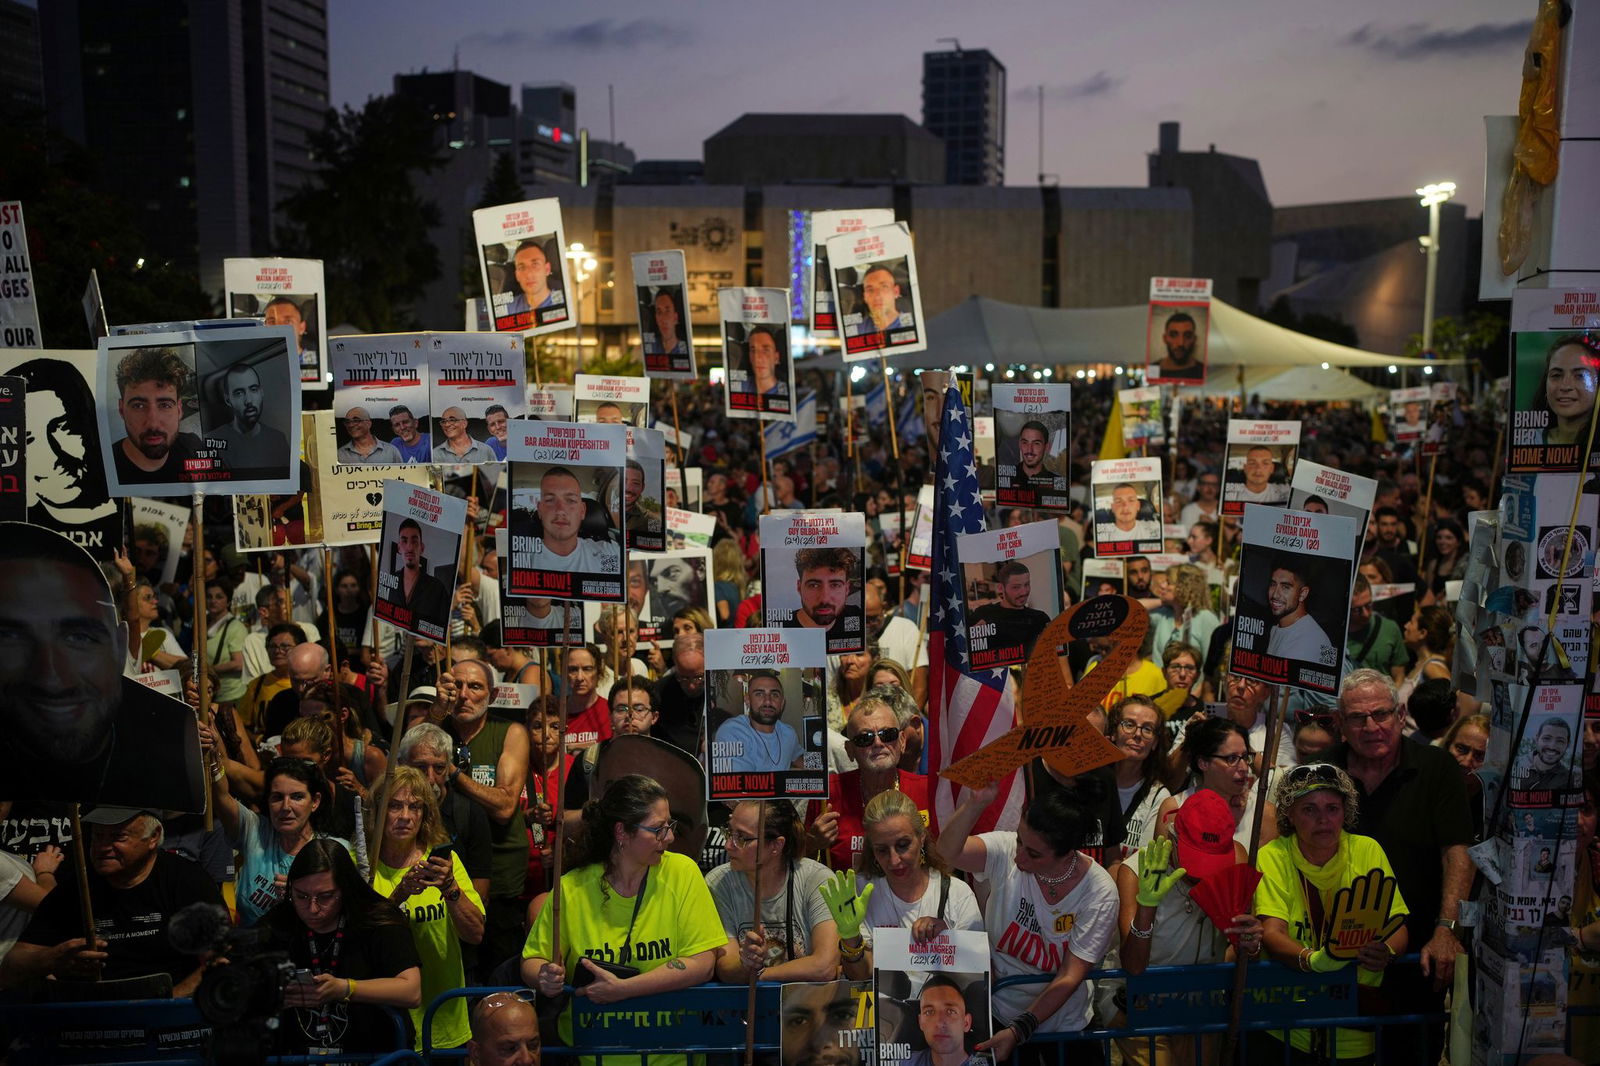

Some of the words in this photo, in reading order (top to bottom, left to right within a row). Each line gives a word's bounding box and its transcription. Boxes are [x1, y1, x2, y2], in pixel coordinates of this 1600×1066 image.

[6, 255, 30, 273] ALL
[0, 278, 30, 299] GES
[1576, 303, 1600, 314] HAYMA
[4, 327, 36, 347] OUR
[353, 351, 388, 366] וליאור
[390, 351, 407, 366] טל
[449, 351, 484, 366] וליאור
[487, 351, 503, 366] טל
[346, 366, 378, 382] לחזור
[382, 368, 418, 382] חייבים
[441, 367, 473, 381] לחזור
[477, 368, 513, 381] חייבים
[1514, 411, 1549, 429] BRING
[525, 436, 537, 446] BAR
[538, 437, 566, 449] ABRAHAM
[568, 440, 610, 450] KUPERSHTEIN
[1513, 428, 1535, 446] HER
[1512, 447, 1544, 465] HOME
[1545, 445, 1580, 465] NOW!
[998, 464, 1017, 477] BRING
[788, 527, 799, 536] GUY
[800, 526, 840, 536] GILBOA-DALAL
[1275, 523, 1297, 537] EVYATAR
[1298, 527, 1320, 539] DAVID
[512, 535, 543, 554] BRING
[996, 542, 1007, 551] ITAY
[1008, 538, 1022, 550] CHEN
[512, 552, 532, 569] HIM
[512, 570, 541, 588] HOME
[543, 572, 573, 591] NOW!
[503, 605, 526, 618] BRING
[767, 608, 793, 621] BRING
[969, 622, 997, 640] BRING
[1237, 613, 1265, 636] BRING
[1235, 631, 1255, 650] HIM
[1563, 629, 1582, 638] שהם
[743, 644, 763, 654] SEGEV
[764, 643, 788, 653] KALFON
[970, 637, 988, 652] HIM
[971, 650, 997, 665] HOME
[998, 643, 1025, 661] NOW!
[1232, 650, 1260, 670] HOME
[1261, 654, 1289, 678] NOW!
[578, 731, 598, 743] EITAN
[1016, 723, 1077, 752] NOW.
[711, 741, 744, 758] BRING
[711, 757, 732, 773] HIM
[712, 775, 742, 791] HOME
[744, 772, 776, 791] NOW!
[1517, 896, 1537, 906] אמא
[414, 902, 445, 923] אתם
[1528, 907, 1541, 924] לך
[1337, 928, 1378, 947] NOW
[636, 937, 672, 962] אתם
[909, 943, 929, 954] MATAN
[930, 945, 957, 955] ANGREST
[879, 1041, 911, 1061] BRING
